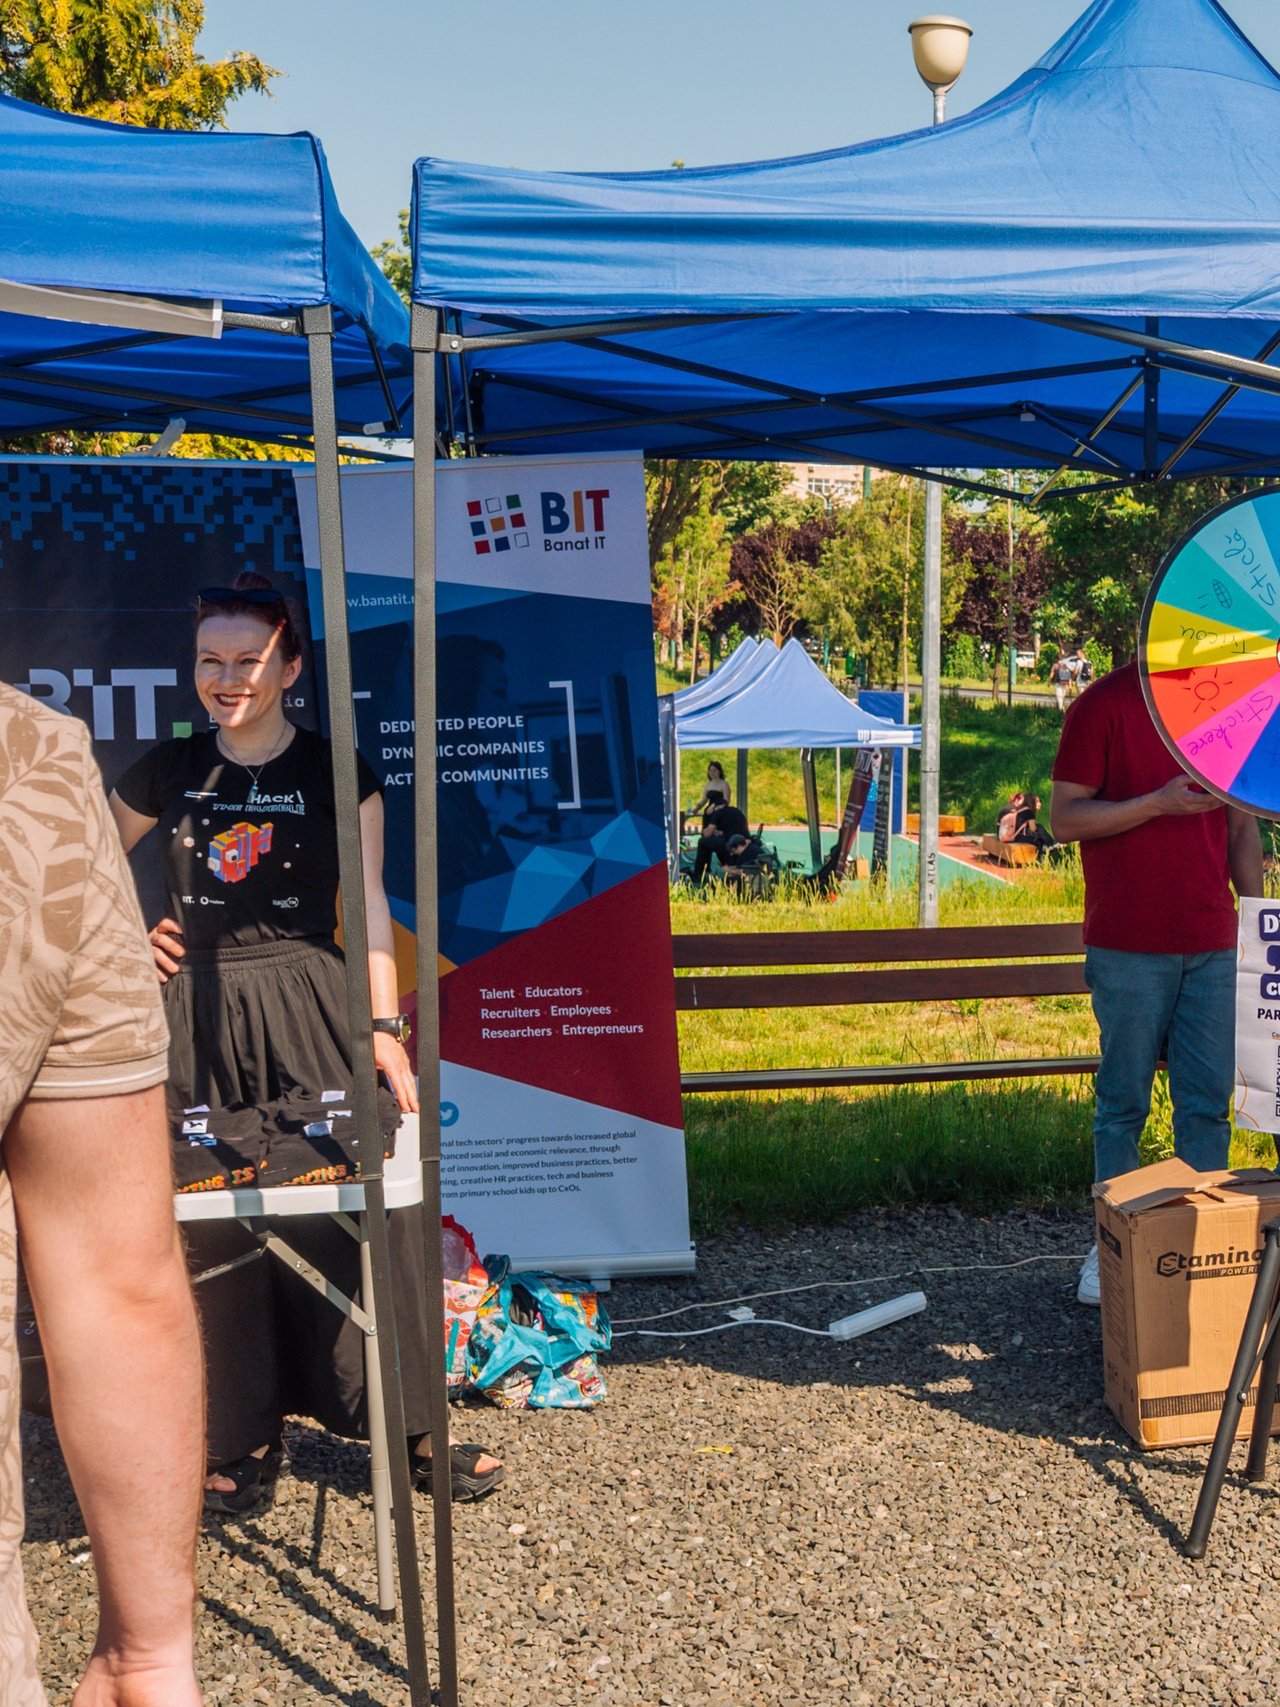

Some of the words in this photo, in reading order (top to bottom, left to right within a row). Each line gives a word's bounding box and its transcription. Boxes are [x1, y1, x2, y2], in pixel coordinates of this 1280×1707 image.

[539, 488, 610, 535] BIT
[543, 536, 590, 552] Banat
[594, 536, 606, 550] IT
[346, 592, 415, 608] w.banatit.
[1180, 623, 1260, 656] Tricou
[379, 717, 465, 734] DEDITED
[467, 715, 525, 730] PEOPLE
[381, 744, 454, 760] DYNIC
[456, 741, 546, 757] COMPANIES
[441, 767, 549, 784] COMMUNITIES
[927, 852, 936, 885] ATLAS
[479, 987, 516, 1000] Talent
[525, 985, 583, 998] Educators
[480, 1006, 541, 1020] Recruiters
[550, 1004, 612, 1019] Employees
[482, 1026, 553, 1040] Researchers
[562, 1023, 645, 1037] Entrepreneurs
[455, 1138, 474, 1147] tech
[506, 1135, 540, 1146] progress
[541, 1133, 573, 1143] towards
[574, 1131, 611, 1141] increased
[612, 1130, 637, 1141] global
[470, 1150, 493, 1159] social
[494, 1149, 509, 1158] and
[510, 1147, 548, 1157] economic
[549, 1146, 589, 1155] relevance,
[589, 1144, 621, 1153] through
[447, 1164, 456, 1173] of
[456, 1163, 502, 1173] innovation,
[502, 1160, 540, 1171] improved
[541, 1159, 574, 1169] business
[575, 1157, 613, 1168] practices,
[613, 1156, 638, 1165] better
[460, 1176, 493, 1185] creative
[494, 1174, 506, 1184] HR
[507, 1173, 546, 1184] practices,
[547, 1171, 565, 1181] tech
[565, 1170, 580, 1180] and
[580, 1170, 614, 1179] business
[441, 1191, 458, 1199] rom
[459, 1189, 491, 1199] primary
[492, 1187, 518, 1197] school
[519, 1186, 536, 1195] kids
[536, 1187, 548, 1195] up
[548, 1186, 557, 1194] to
[557, 1183, 582, 1193] CxOs.
